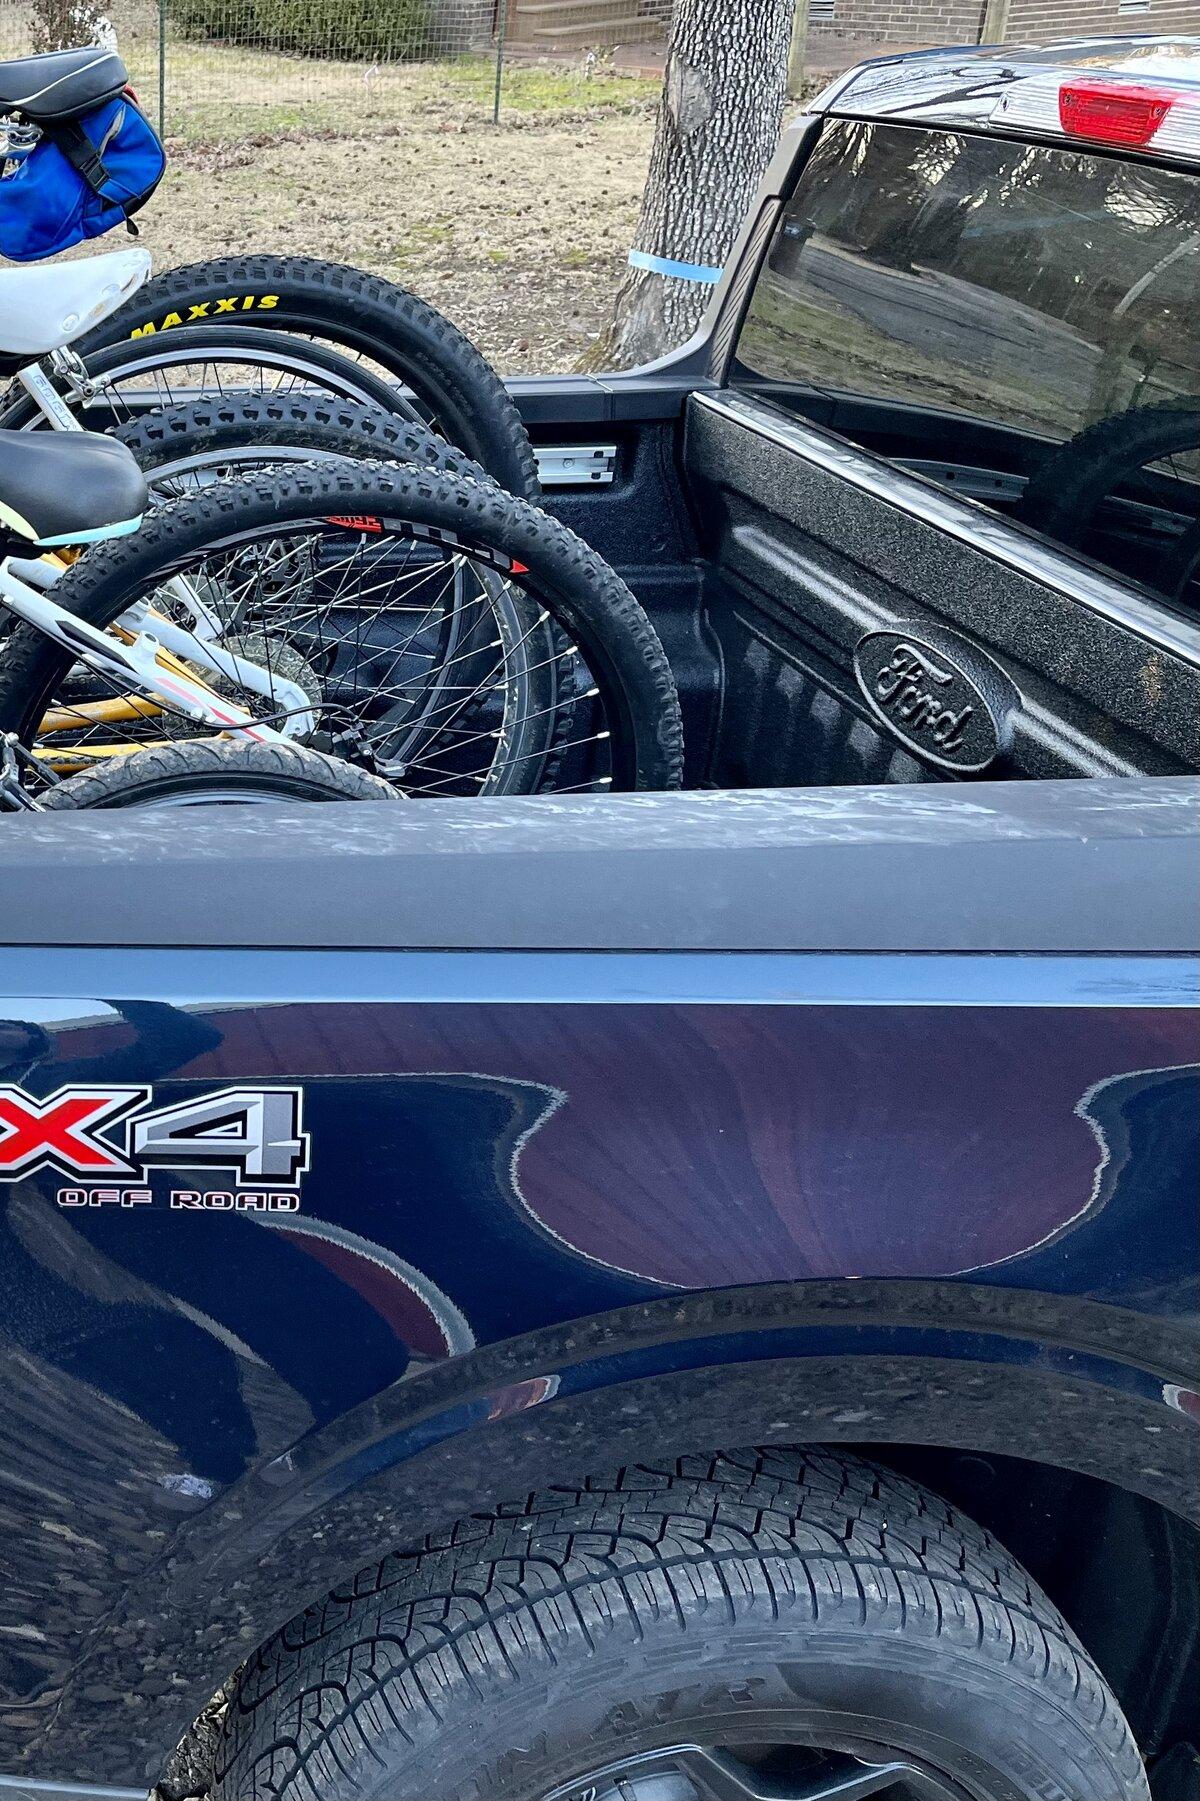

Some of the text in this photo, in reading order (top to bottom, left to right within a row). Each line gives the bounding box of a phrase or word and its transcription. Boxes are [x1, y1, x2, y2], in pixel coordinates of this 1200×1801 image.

[130, 295, 280, 341] MAXXIS
[876, 643, 974, 752] Ford
[57, 1188, 300, 1212] OFF ROAD
